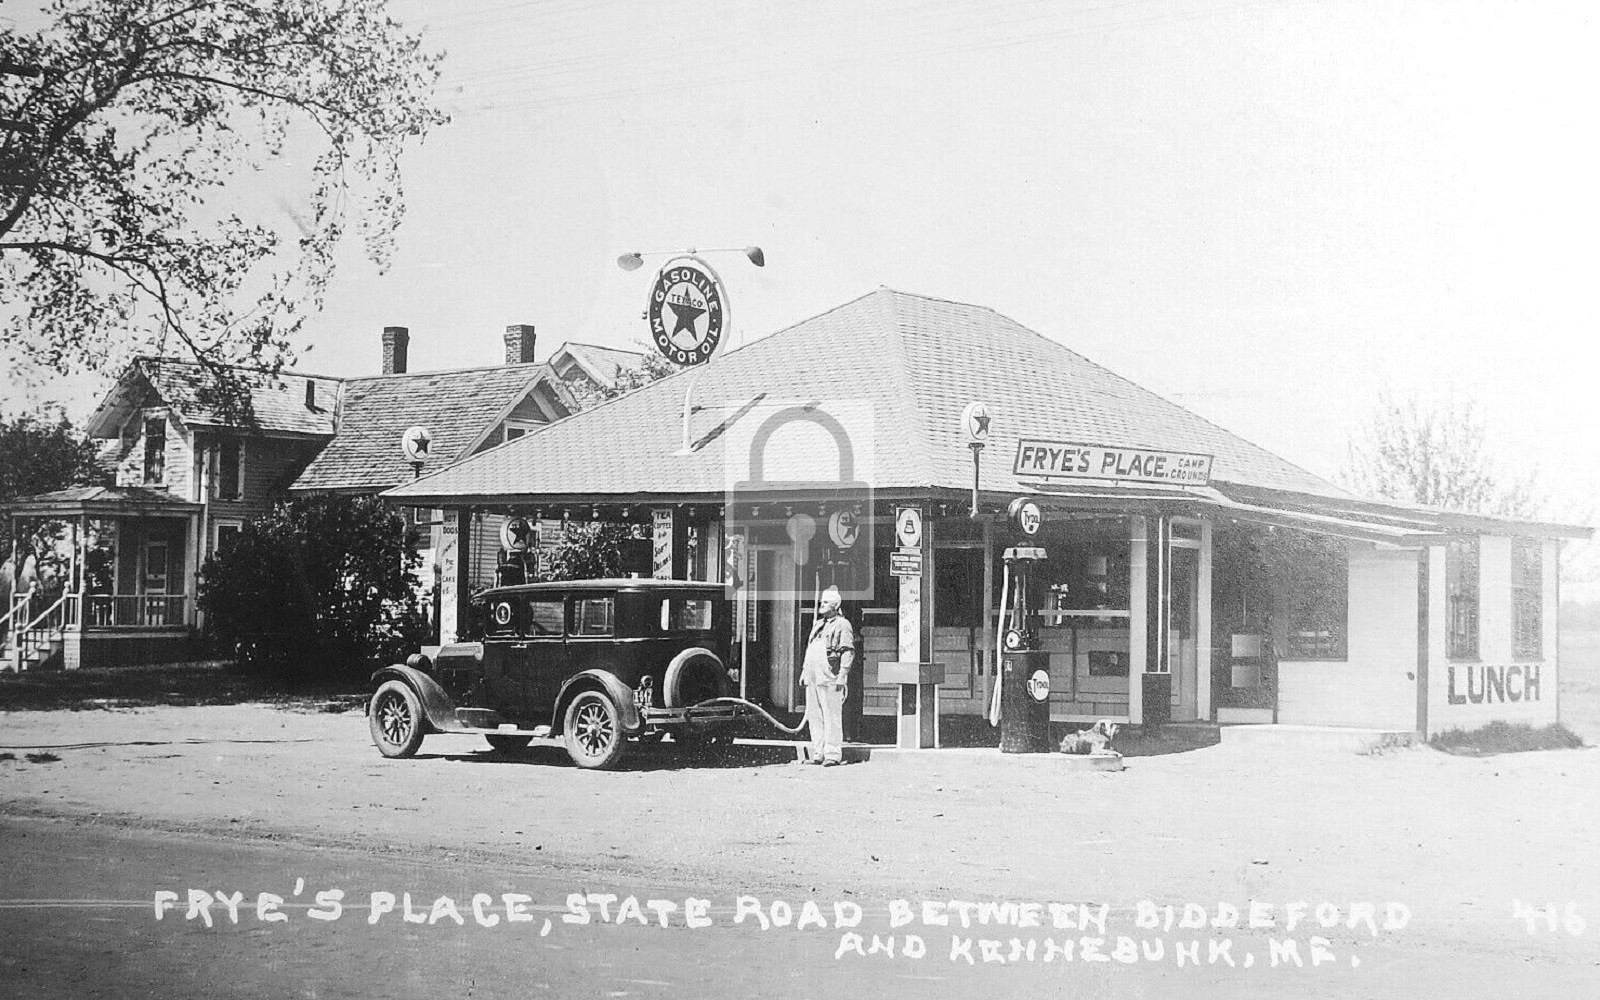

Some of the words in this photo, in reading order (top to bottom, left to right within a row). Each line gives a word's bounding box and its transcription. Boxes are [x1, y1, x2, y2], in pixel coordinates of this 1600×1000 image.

[655, 269, 718, 313] GASOLINE
[653, 317, 698, 363] MOTOR
[701, 327, 718, 354] OIL
[1020, 446, 1090, 473] FRYE'S
[1178, 457, 1205, 469] CAMP
[654, 511, 672, 520] TEA
[443, 526, 458, 535] DOGS
[1447, 665, 1540, 705] LUNCH
